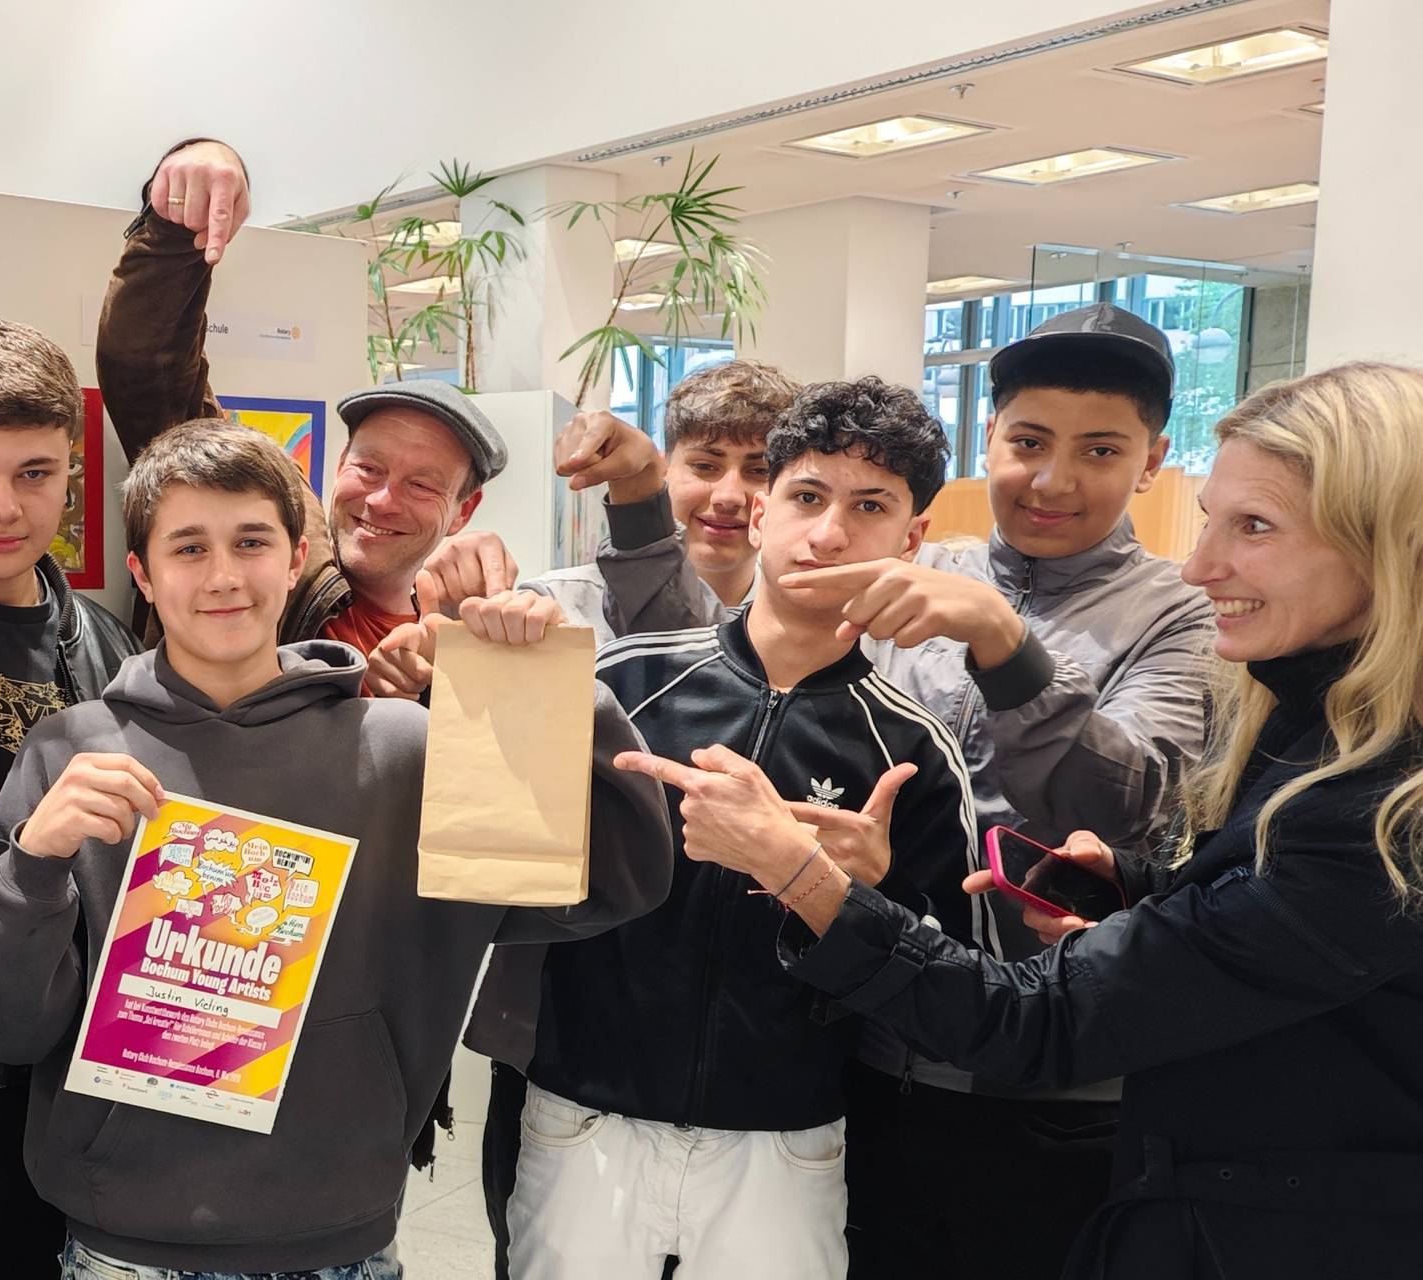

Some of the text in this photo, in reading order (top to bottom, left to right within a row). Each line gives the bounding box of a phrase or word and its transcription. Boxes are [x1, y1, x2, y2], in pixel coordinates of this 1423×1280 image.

[247, 842, 267, 851] Mein
[145, 917, 282, 985] Urkunde
[140, 957, 272, 1001] Bochum Young Artists
[146, 985, 182, 1002] Justin
[118, 1011, 128, 1019] zum
[129, 1012, 143, 1022] Thema
[212, 1031, 221, 1040] und
[239, 1037, 247, 1046] der
[248, 1039, 262, 1049] Klasse
[182, 1013, 190, 1021] des
[190, 1015, 204, 1027] Rotary
[163, 1030, 172, 1040] den
[123, 1049, 138, 1062] Rotary
[139, 1052, 149, 1062] Club
[196, 1066, 215, 1078] Bochum,
